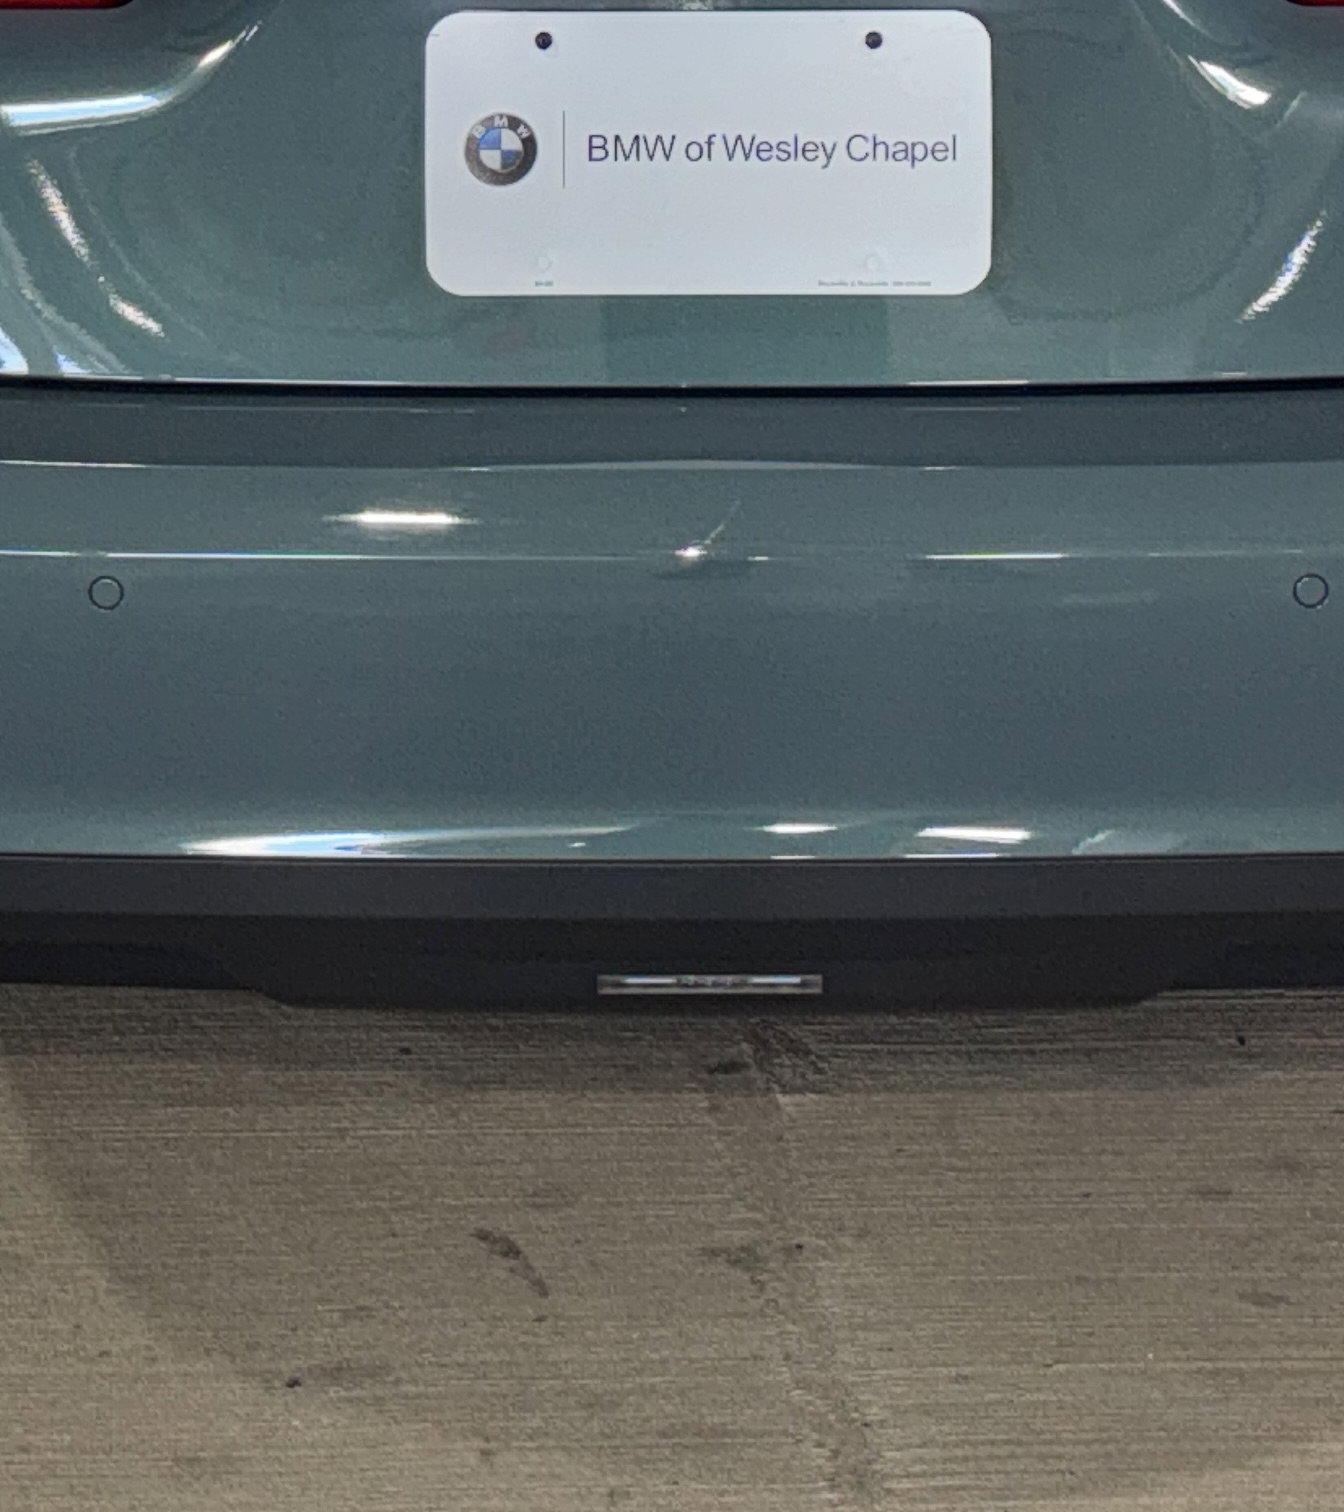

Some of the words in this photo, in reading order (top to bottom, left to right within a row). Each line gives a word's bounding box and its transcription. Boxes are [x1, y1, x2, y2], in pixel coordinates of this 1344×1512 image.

[471, 115, 532, 139] BMW
[588, 134, 676, 162] BMW
[684, 133, 717, 162] of
[722, 133, 837, 169] Wesley
[846, 133, 957, 169] Chapel
